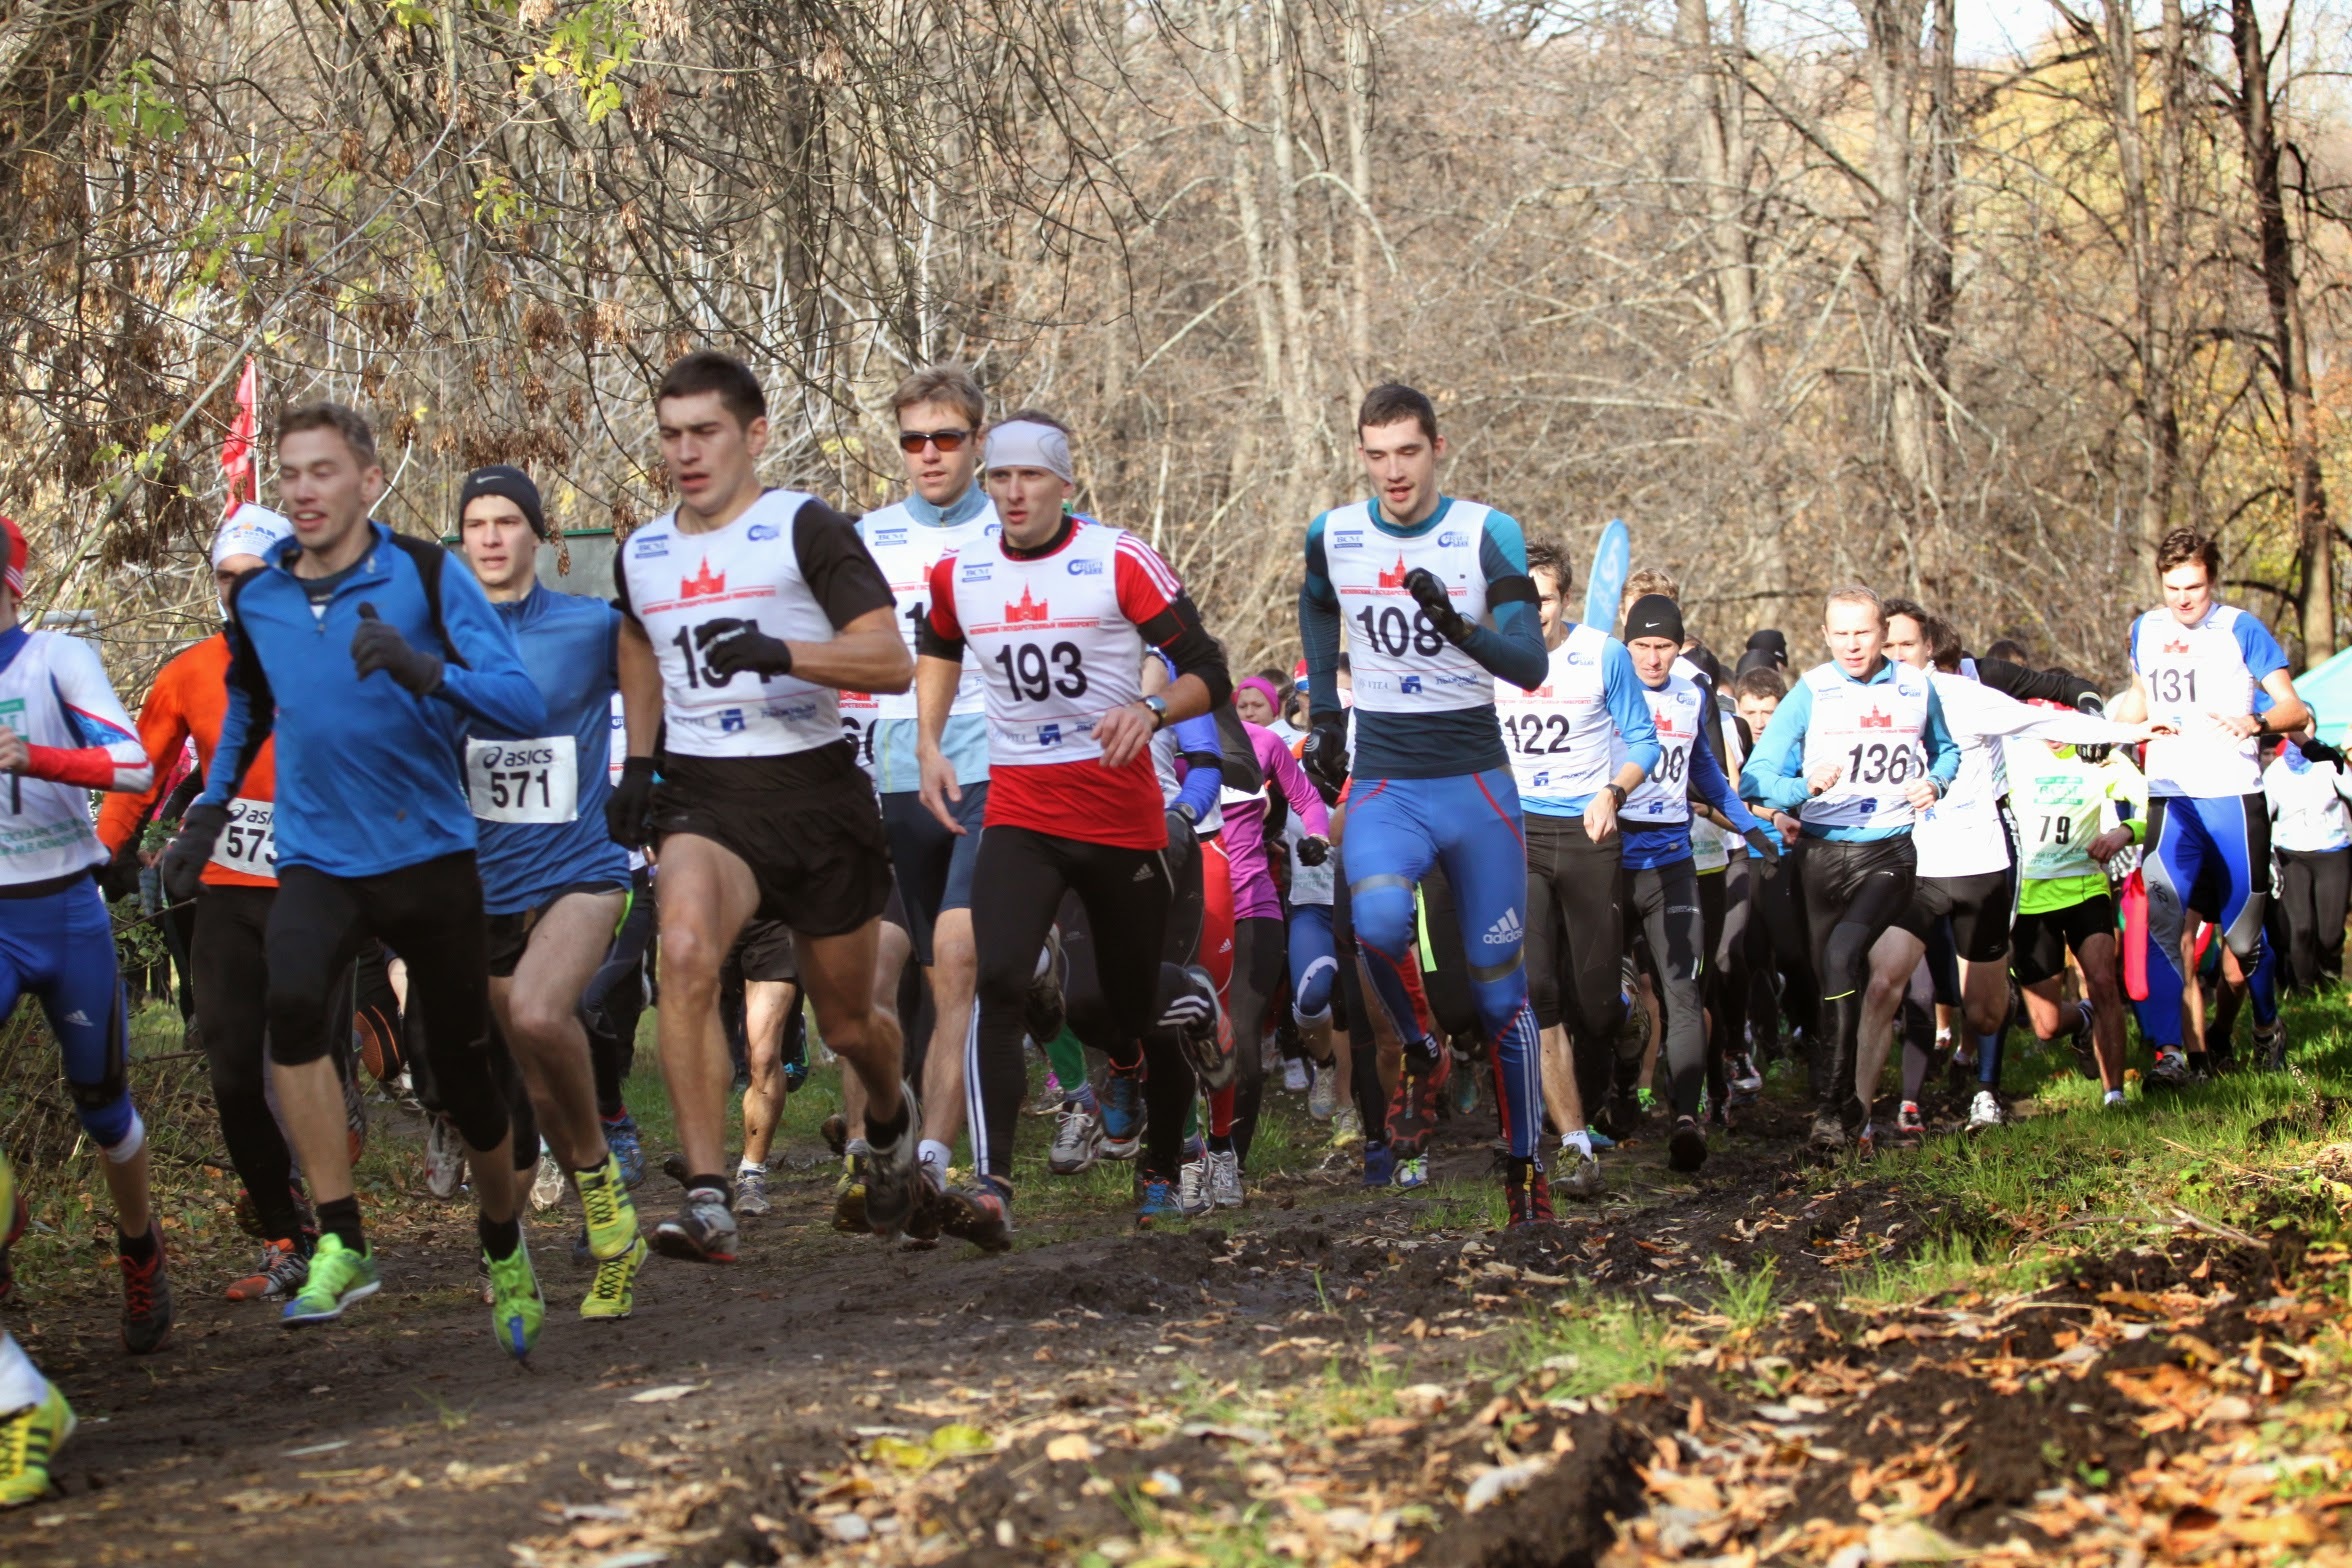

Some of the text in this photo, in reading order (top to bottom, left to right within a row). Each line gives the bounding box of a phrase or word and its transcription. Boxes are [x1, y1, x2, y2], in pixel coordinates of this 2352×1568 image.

[1357, 605, 1443, 657] 108
[995, 641, 1087, 702] 193
[2149, 669, 2196, 703] 131
[1504, 714, 1571, 755] 122
[504, 749, 553, 767] asics
[1848, 743, 1911, 785] 136
[491, 769, 550, 809] 571
[2039, 815, 2071, 845] 79
[1483, 928, 1523, 945] adidas
